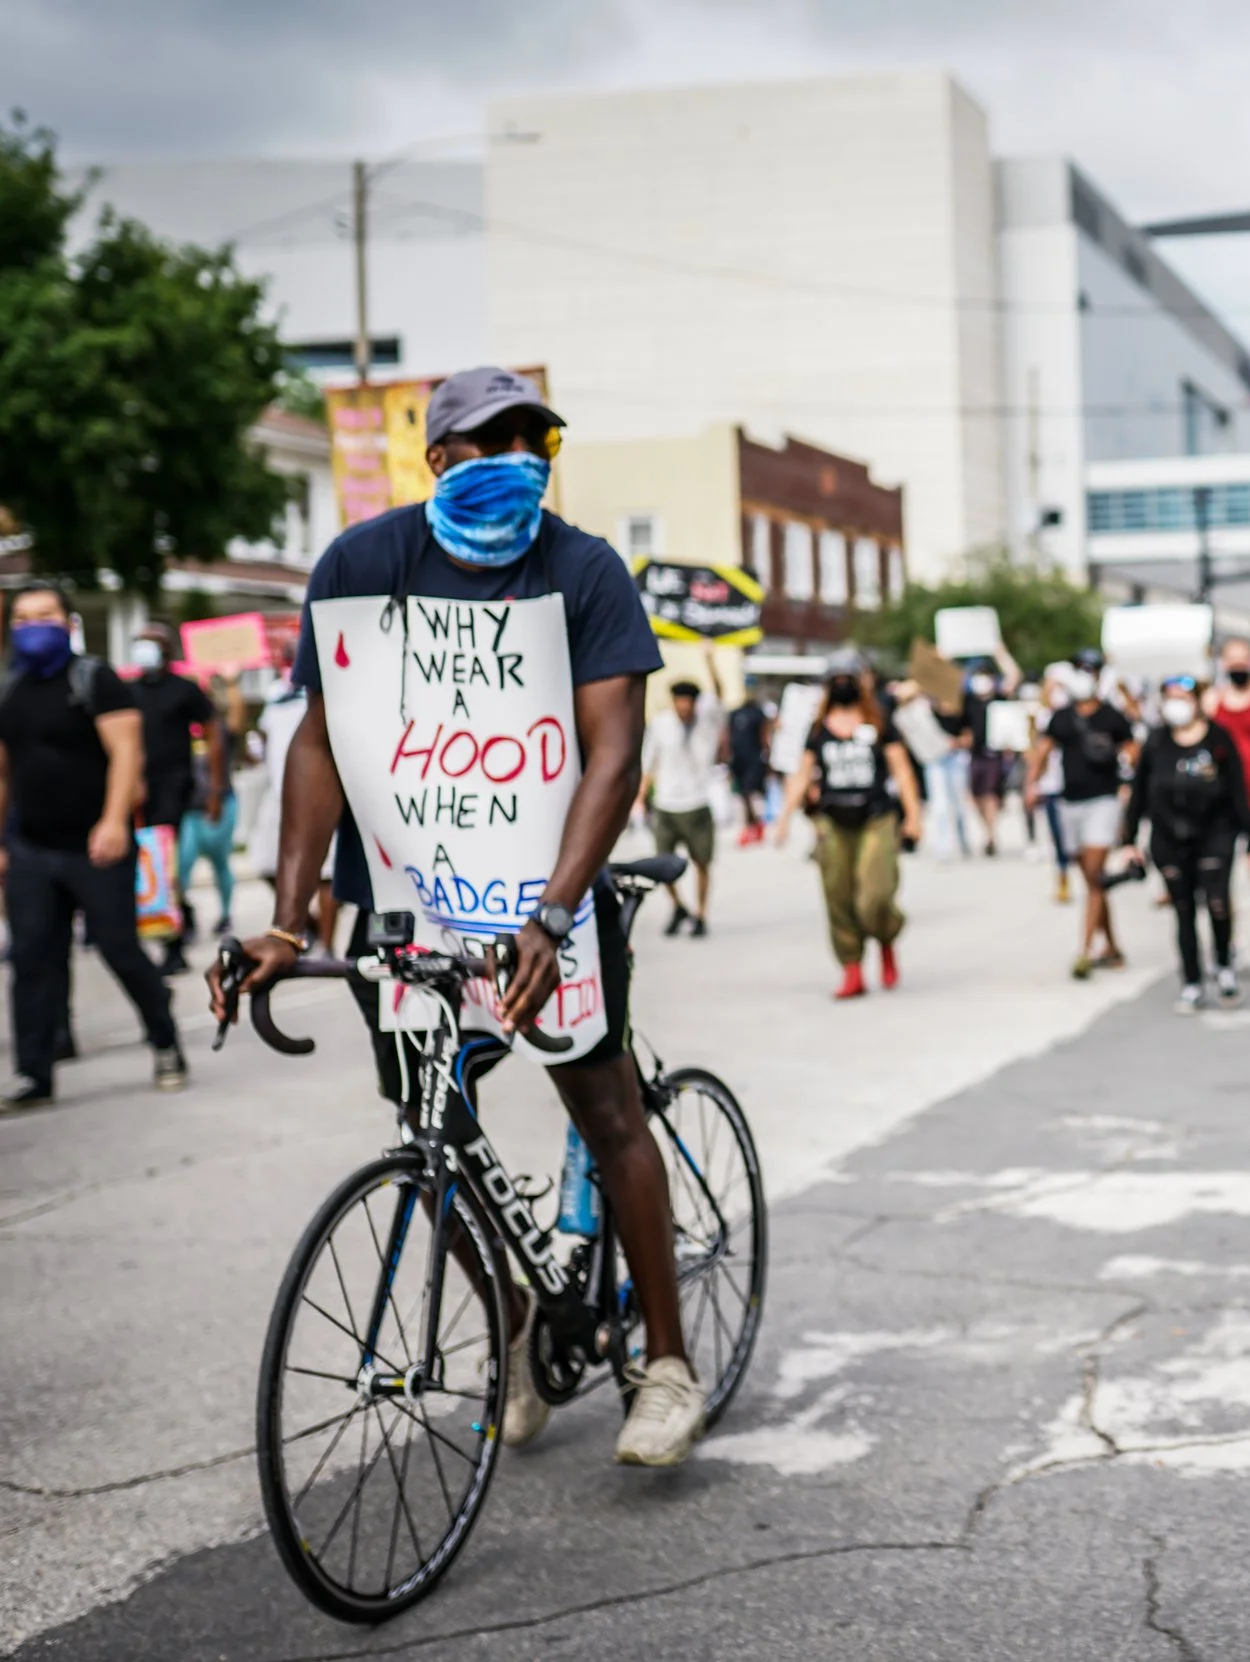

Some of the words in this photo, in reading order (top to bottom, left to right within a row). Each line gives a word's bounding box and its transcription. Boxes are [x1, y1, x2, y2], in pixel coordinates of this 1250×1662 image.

[418, 600, 511, 652] WHY
[413, 650, 524, 689] WEAR
[453, 688, 469, 718] A
[391, 716, 566, 782] HOOD
[395, 786, 518, 828] WHEN
[432, 843, 457, 876] A
[404, 866, 548, 915] BADGE
[463, 1135, 570, 1293] FOCUS
